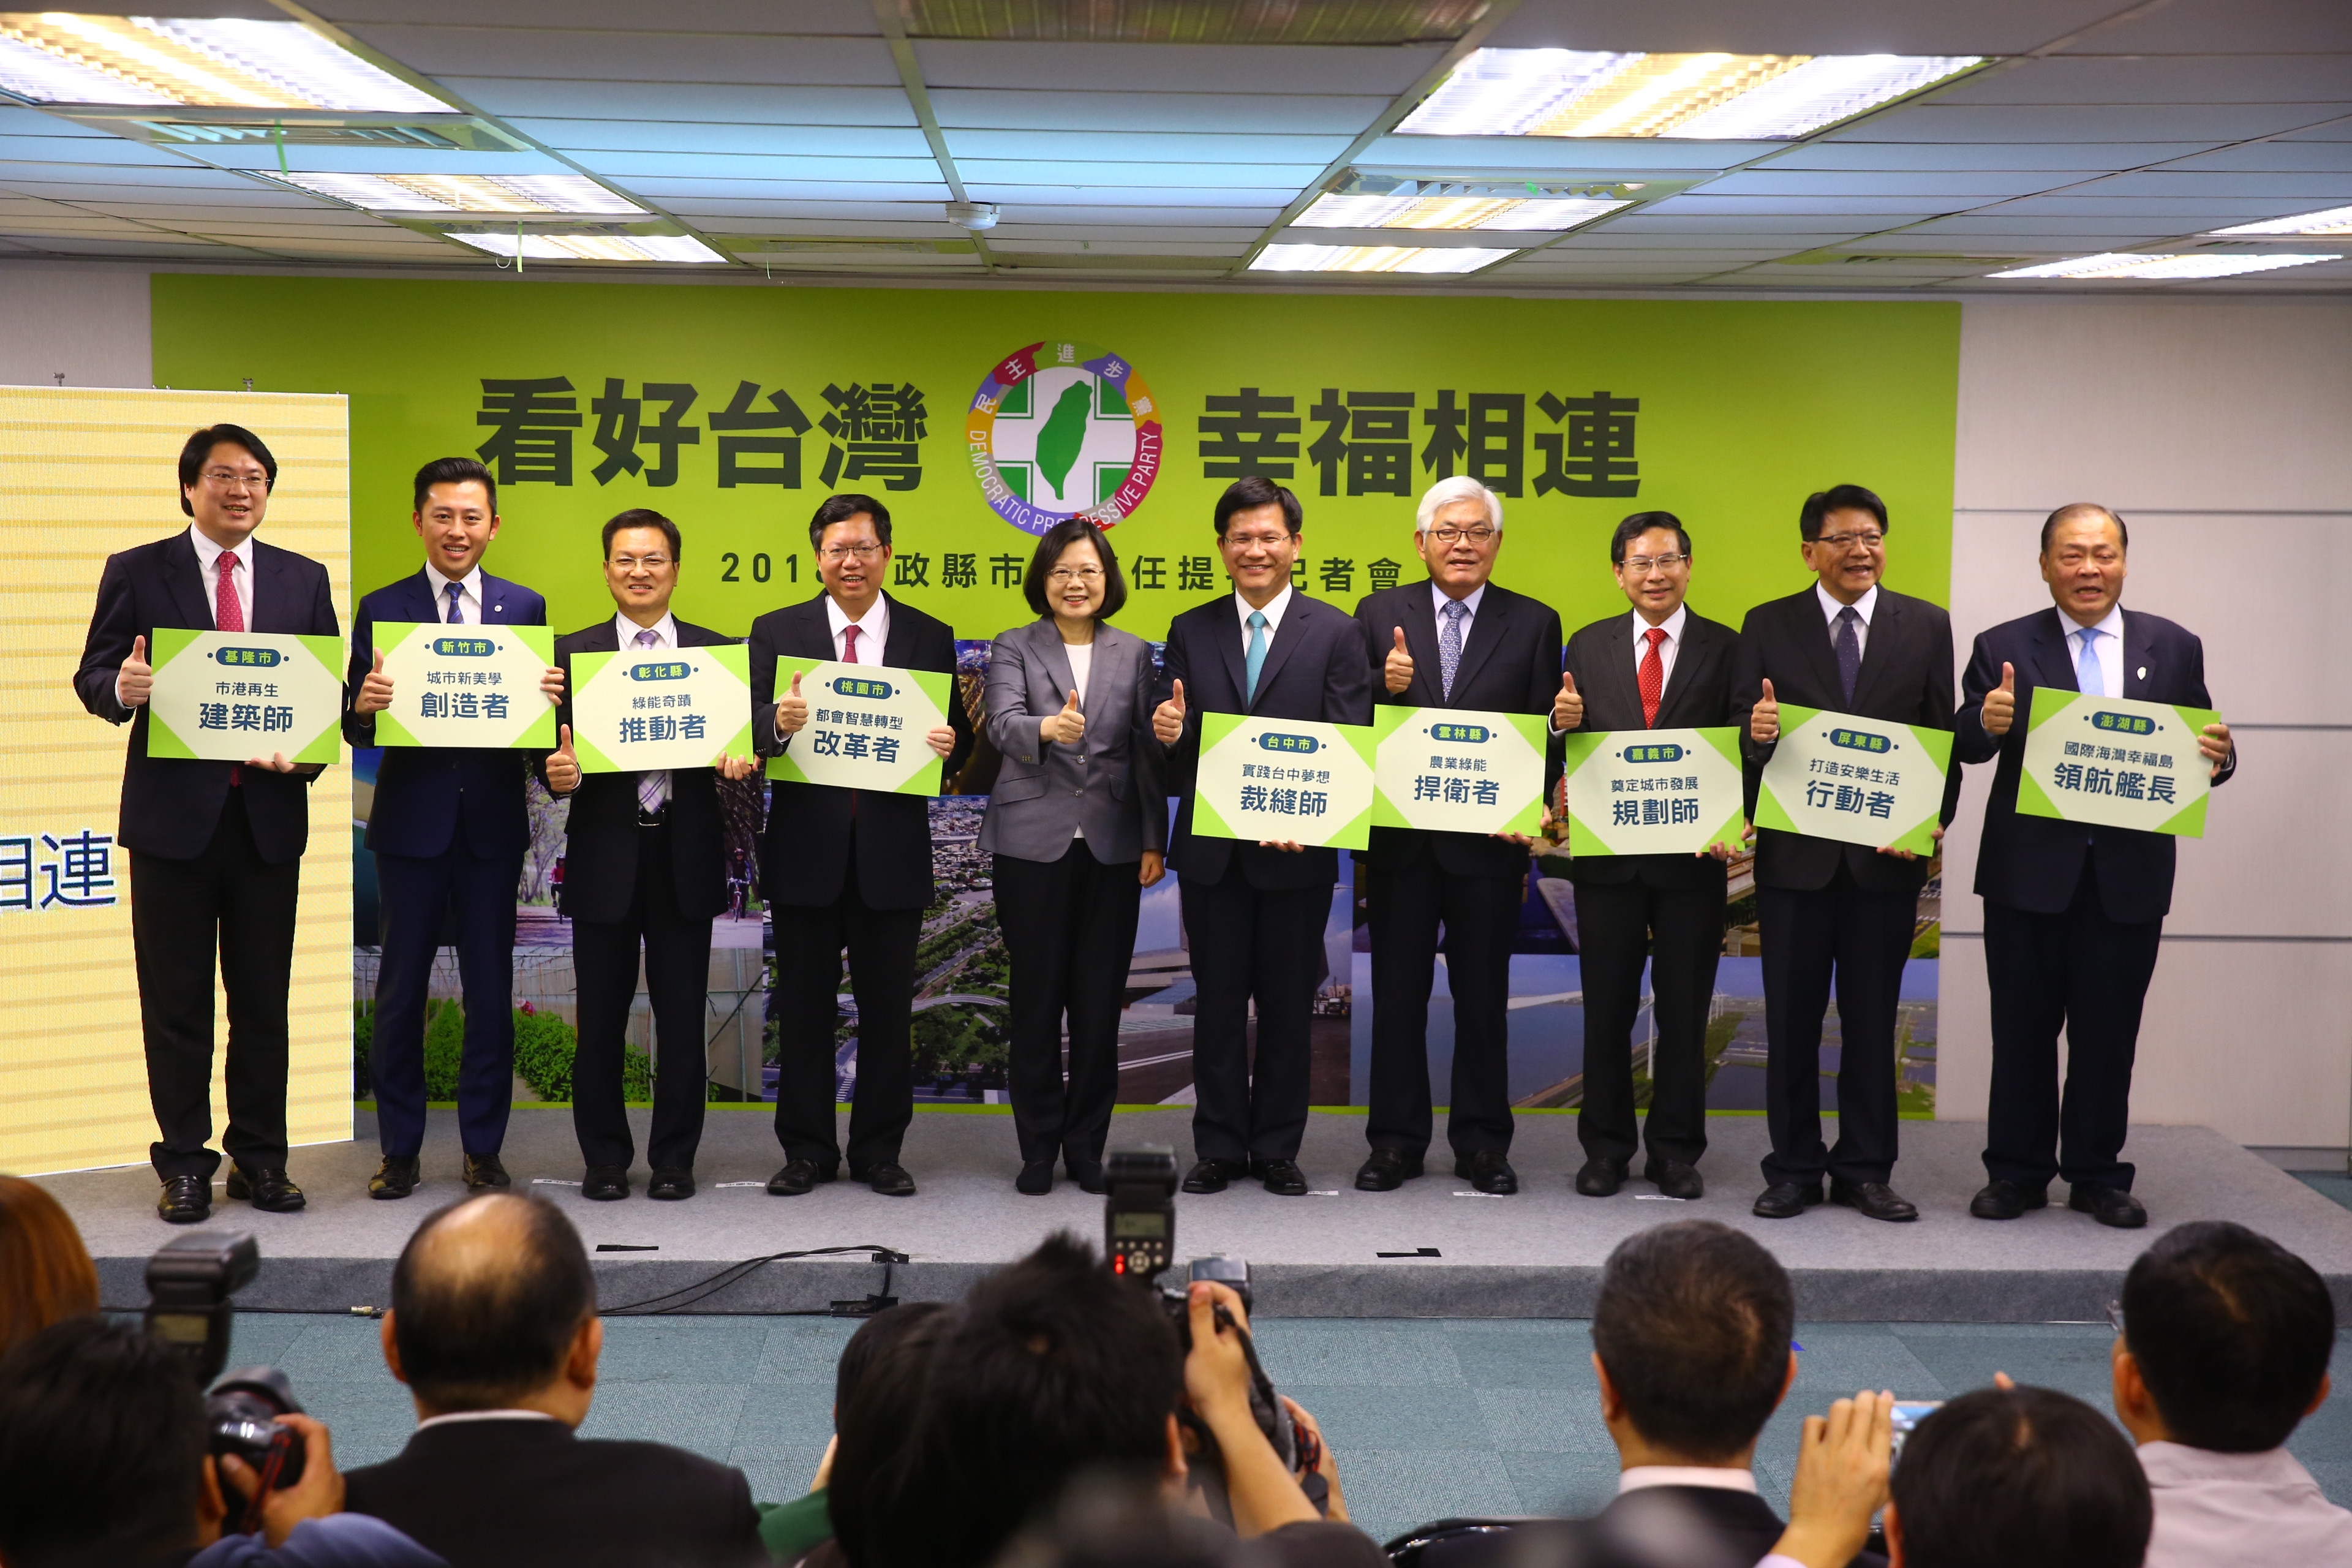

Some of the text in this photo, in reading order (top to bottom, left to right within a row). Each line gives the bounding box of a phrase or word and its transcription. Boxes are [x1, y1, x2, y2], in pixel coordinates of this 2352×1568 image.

[975, 343, 1152, 417] 民主進步黨
[475, 376, 1642, 499] 看好台灣 幸福相連
[970, 430, 1030, 525] DEMOCRATIC
[1135, 432, 1158, 488] PARTY
[225, 650, 272, 664] 基隆市
[442, 641, 486, 654] 新竹市
[428, 671, 501, 685] 城市新美學
[639, 665, 683, 678] 彰化縣
[216, 682, 278, 696] 市港再生
[841, 680, 884, 696] 桃園市
[421, 692, 509, 718] 創造者
[633, 695, 690, 709] 綠能奇蹟
[199, 703, 293, 732] 建築師
[816, 708, 903, 731] 都會智慧轉型
[2100, 715, 2147, 732] 澎湖縣
[620, 714, 706, 742] 推動者
[1439, 726, 1482, 740] 雲林縣
[814, 730, 900, 763] 改革者
[1268, 736, 1311, 750] 台中市
[1838, 731, 1883, 750] 屏東縣
[1632, 747, 1675, 760] 嘉義市
[2064, 741, 2173, 769] 國際海灣幸福島
[1430, 756, 1486, 771] 農業綠能
[1809, 758, 1900, 786] 打造安樂生活
[1243, 764, 1329, 783] 實踐台中夢想
[2054, 762, 2176, 804] 領航艦長
[1611, 777, 1698, 792] 奠定城市發展
[1241, 785, 1327, 816] 裁縫師
[1806, 780, 1894, 820] 行動者
[1613, 799, 1698, 826] 規劃師
